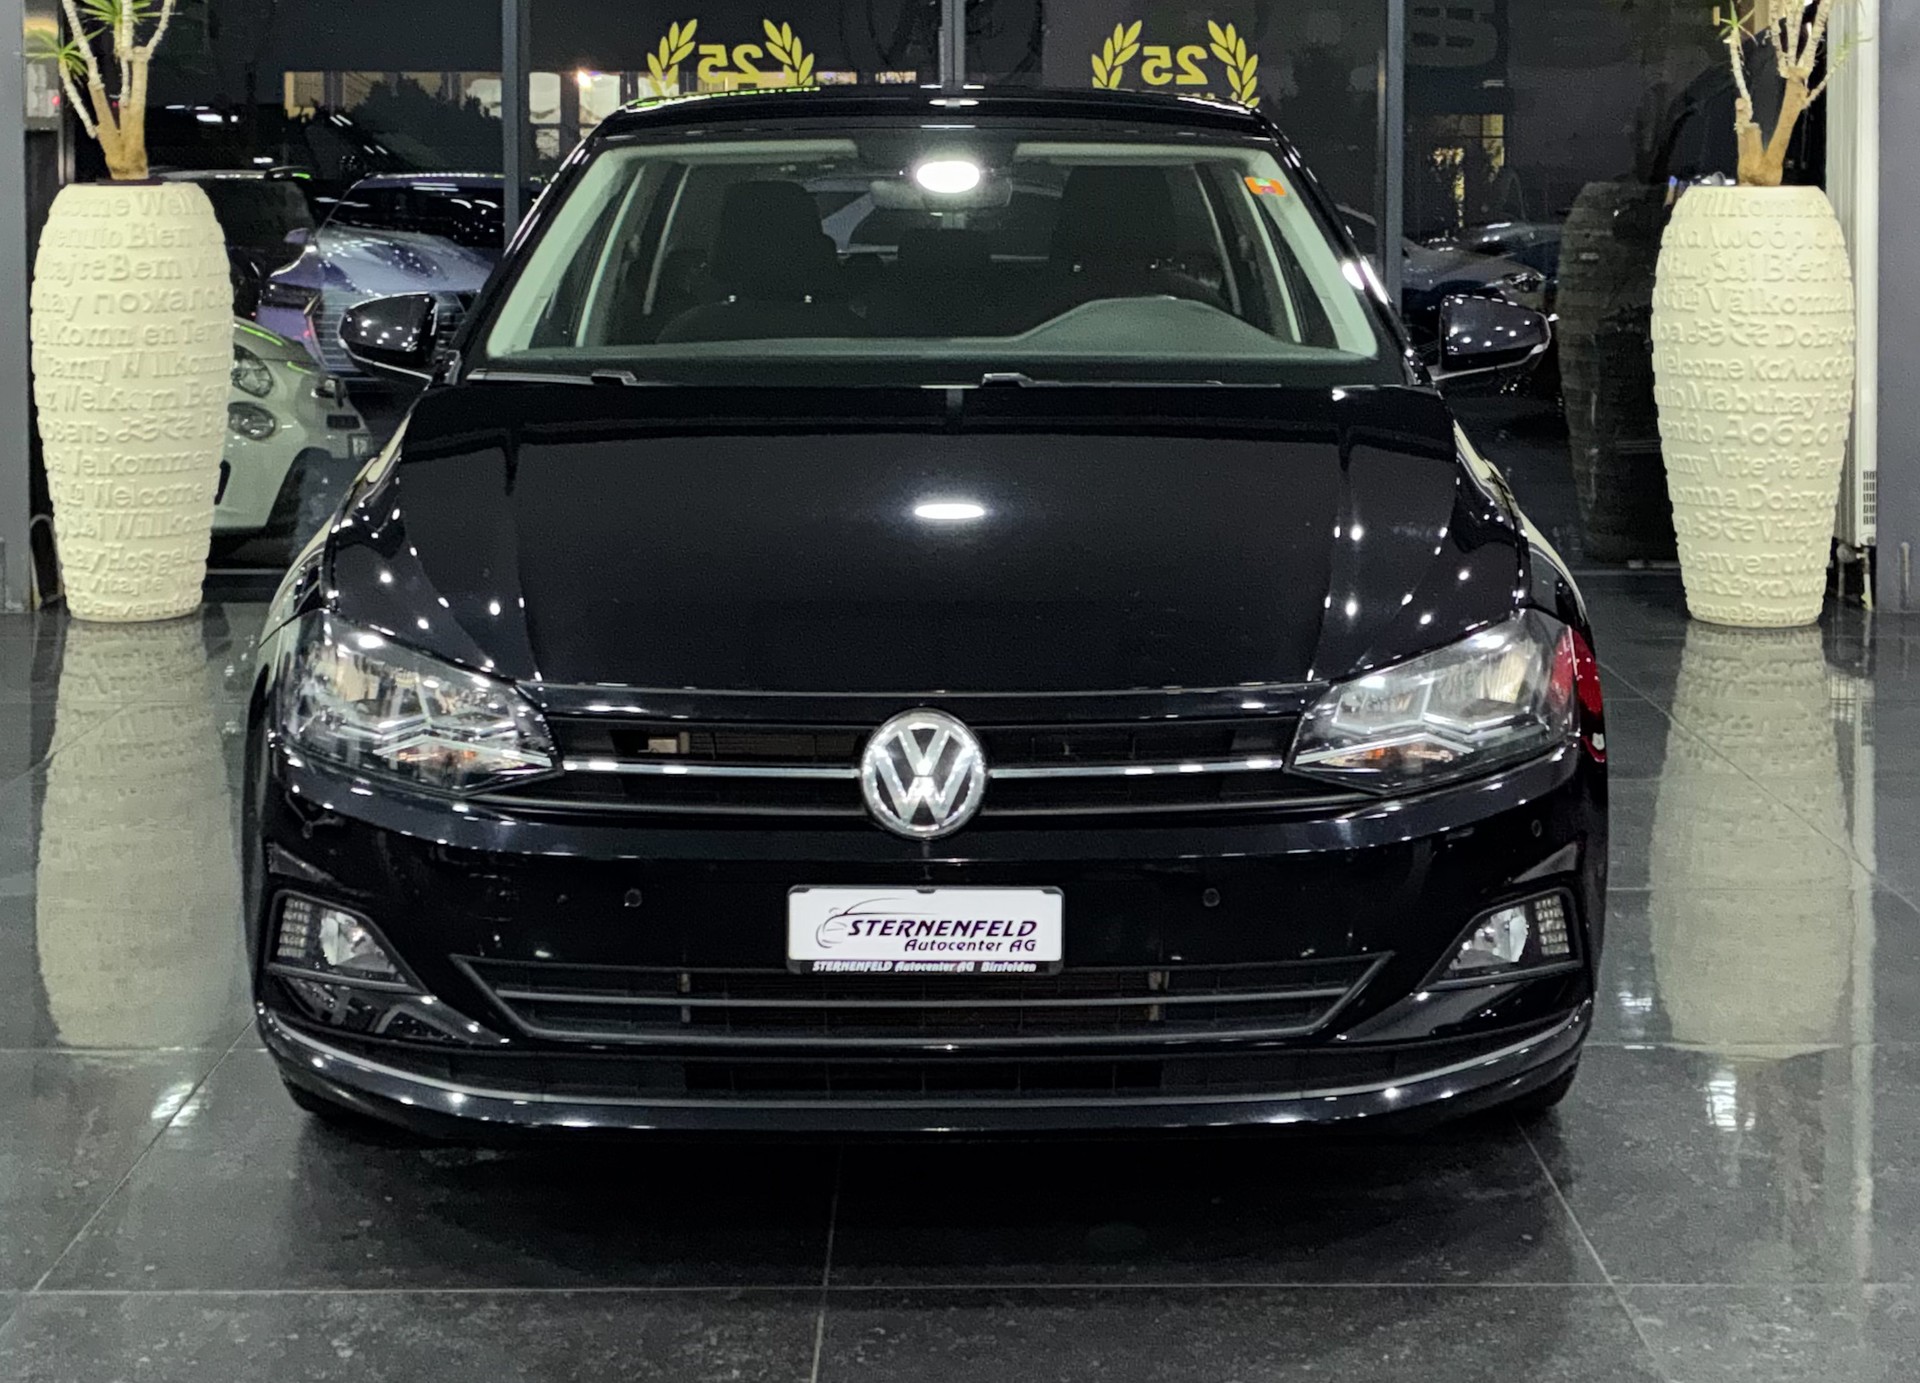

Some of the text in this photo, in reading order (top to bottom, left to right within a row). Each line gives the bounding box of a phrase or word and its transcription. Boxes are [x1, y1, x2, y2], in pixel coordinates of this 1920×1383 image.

[866, 713, 984, 835] VW
[847, 919, 1038, 939] STERNENFELD
[904, 938, 1037, 952] Autocenter AG
[812, 960, 893, 973] STERNENFELD
[894, 961, 956, 973] Autocenter
[957, 961, 975, 973] AG
